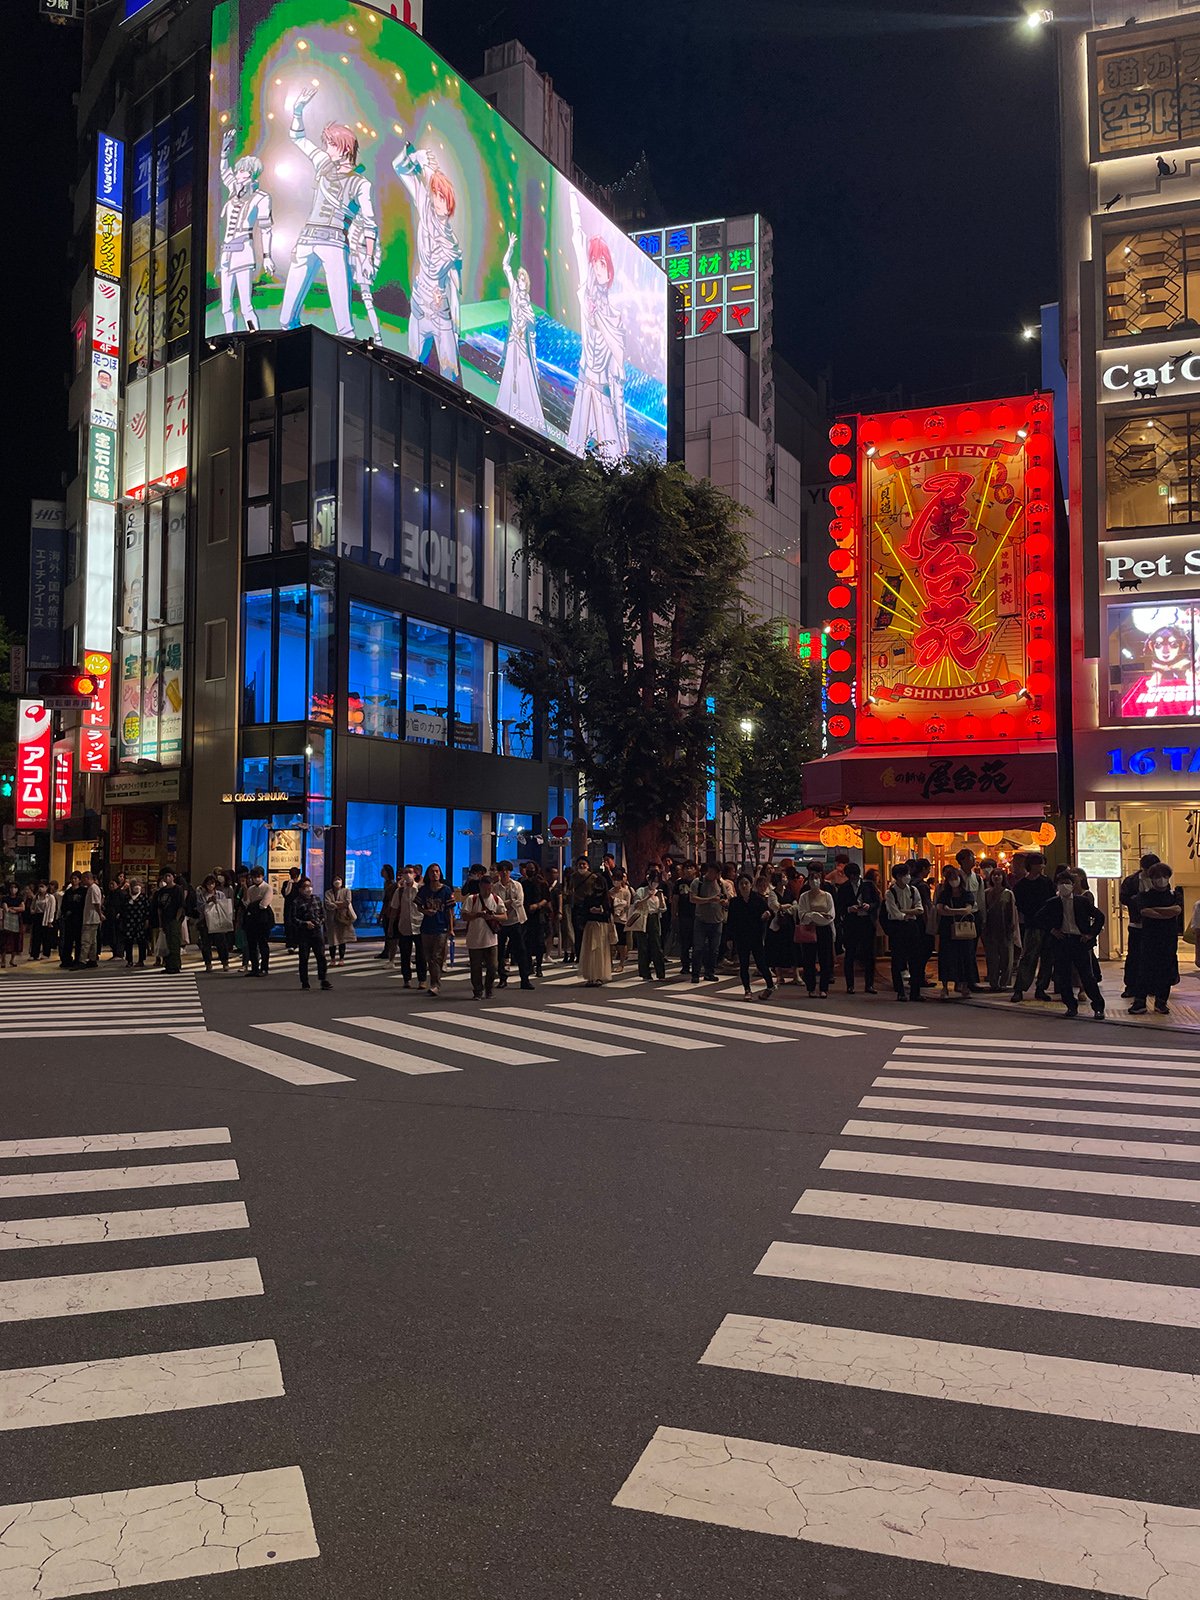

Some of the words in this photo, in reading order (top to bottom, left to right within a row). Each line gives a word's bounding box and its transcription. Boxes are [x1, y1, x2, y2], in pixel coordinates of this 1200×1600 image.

[684, 305, 751, 333] ダヤ
[100, 343, 112, 353] 4F
[1103, 361, 1176, 390] Cat
[94, 431, 111, 499] 宝石広場
[906, 445, 988, 464] YATAIEN
[35, 508, 63, 521] HIS
[1106, 555, 1173, 581] Pet
[903, 685, 991, 699] SHINJUKU
[22, 746, 46, 802] アコム
[1107, 748, 1156, 775] 16
[234, 792, 256, 802] CROSS
[257, 792, 289, 801] SHINJUKU
